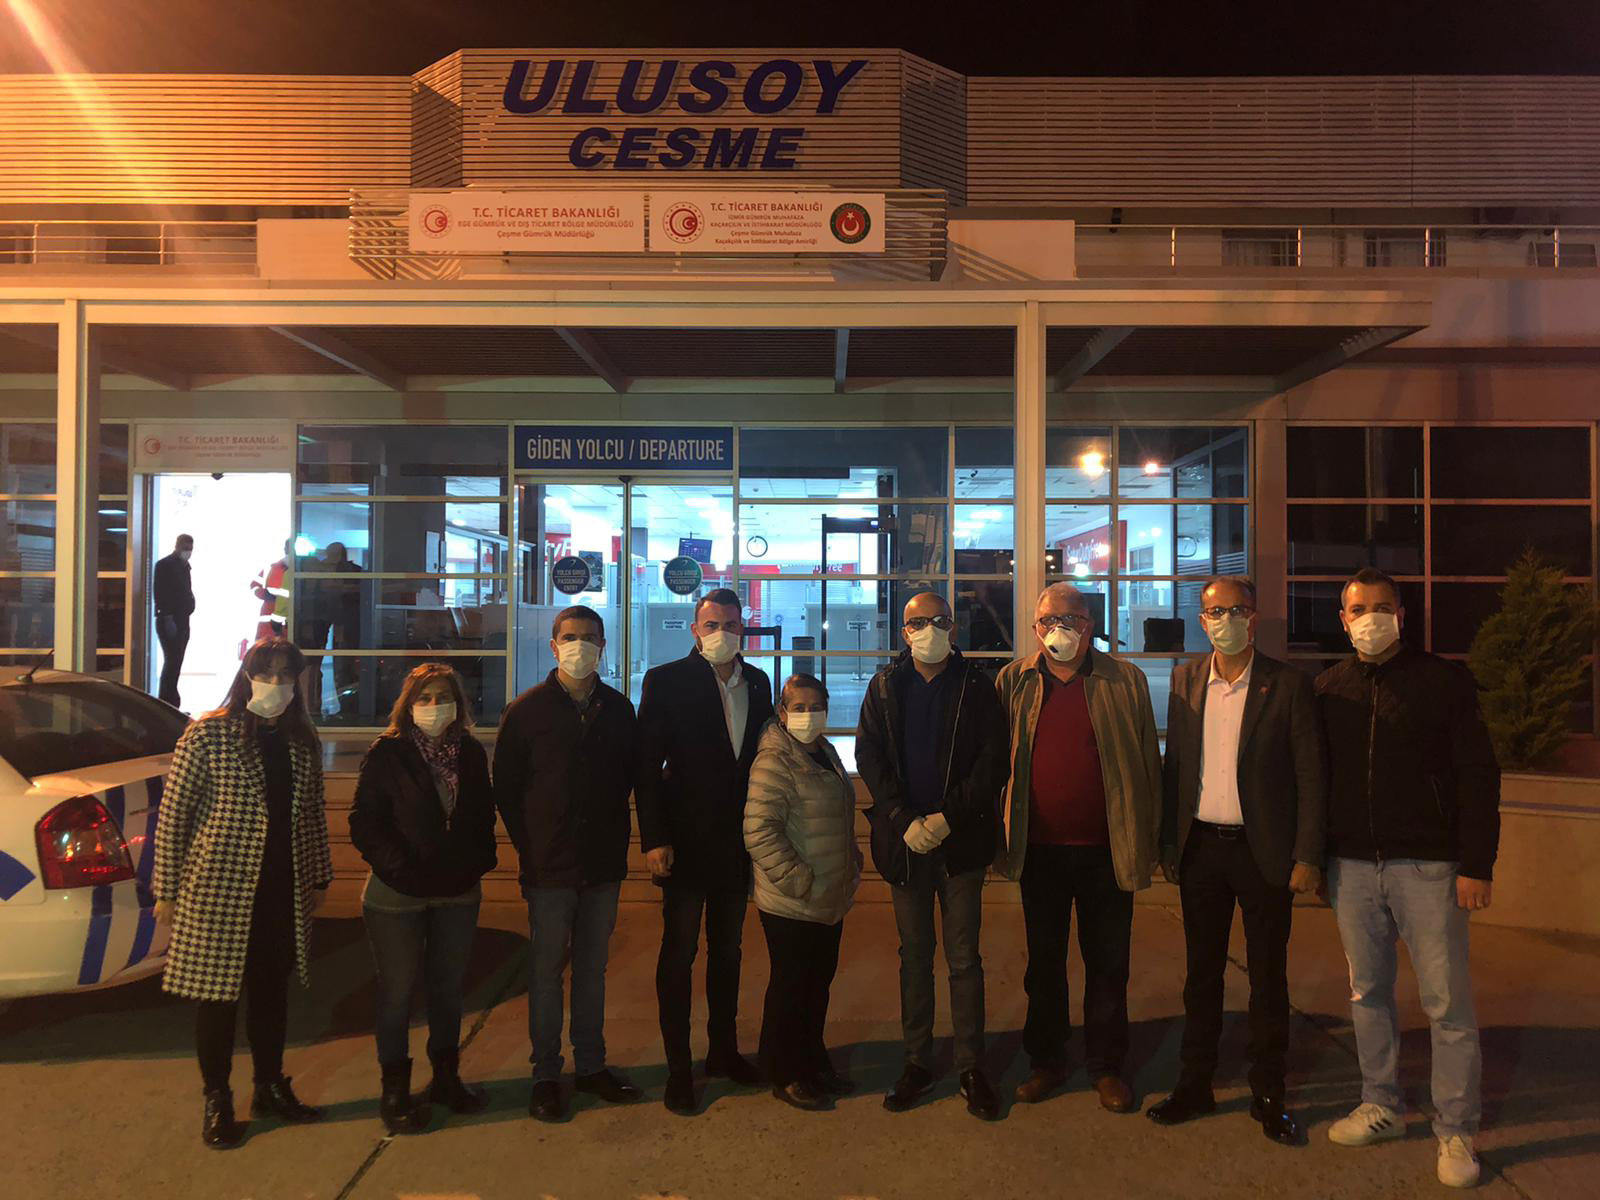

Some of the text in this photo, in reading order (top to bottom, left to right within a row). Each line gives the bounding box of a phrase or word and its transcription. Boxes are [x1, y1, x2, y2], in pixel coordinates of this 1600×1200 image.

[502, 59, 869, 115] ULUSOY
[568, 127, 806, 169] CESME
[472, 205, 620, 218] T.C. TİCARET BAKANLIĞI
[710, 202, 726, 211] T.C.
[729, 201, 767, 212] TİCARET
[770, 201, 823, 212] BAKANLIĞI
[527, 434, 724, 461] GİDEN YOLCU / DEPARTURE
